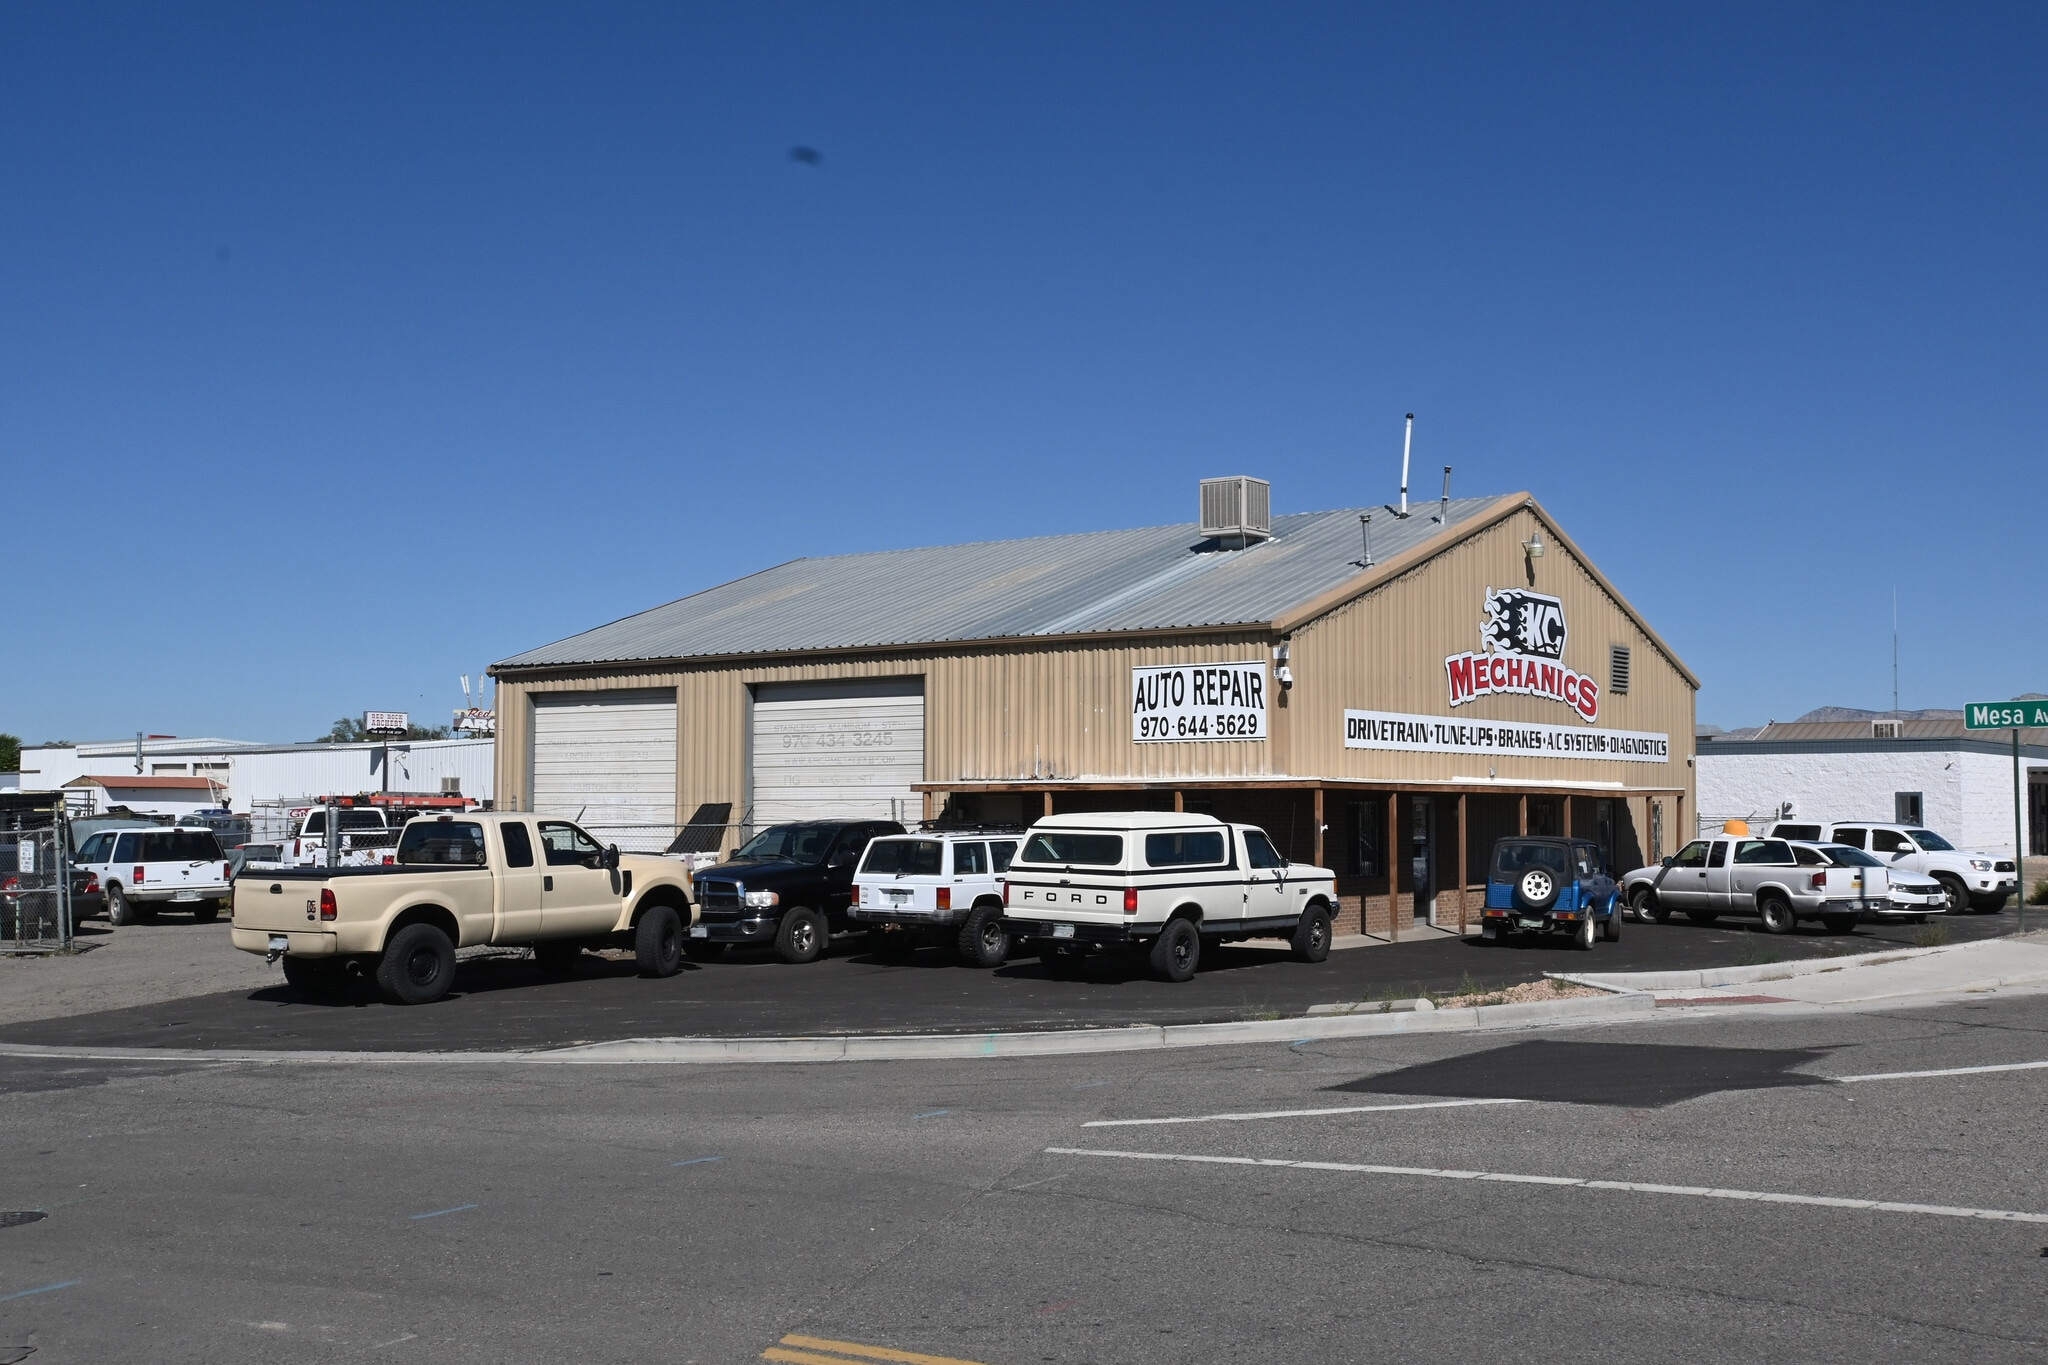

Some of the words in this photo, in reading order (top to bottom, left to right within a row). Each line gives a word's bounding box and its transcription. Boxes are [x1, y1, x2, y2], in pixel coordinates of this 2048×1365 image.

[1525, 602, 1565, 654] KC
[1133, 670, 1185, 713] AUTO
[1193, 668, 1265, 710] REPAIR
[1448, 655, 1599, 718] MECHANICS
[371, 719, 403, 727] ARCHERY
[1973, 705, 2024, 726] Mesa
[816, 733, 846, 748] 434
[853, 731, 895, 747] 3245
[1024, 891, 1107, 905] FORD
